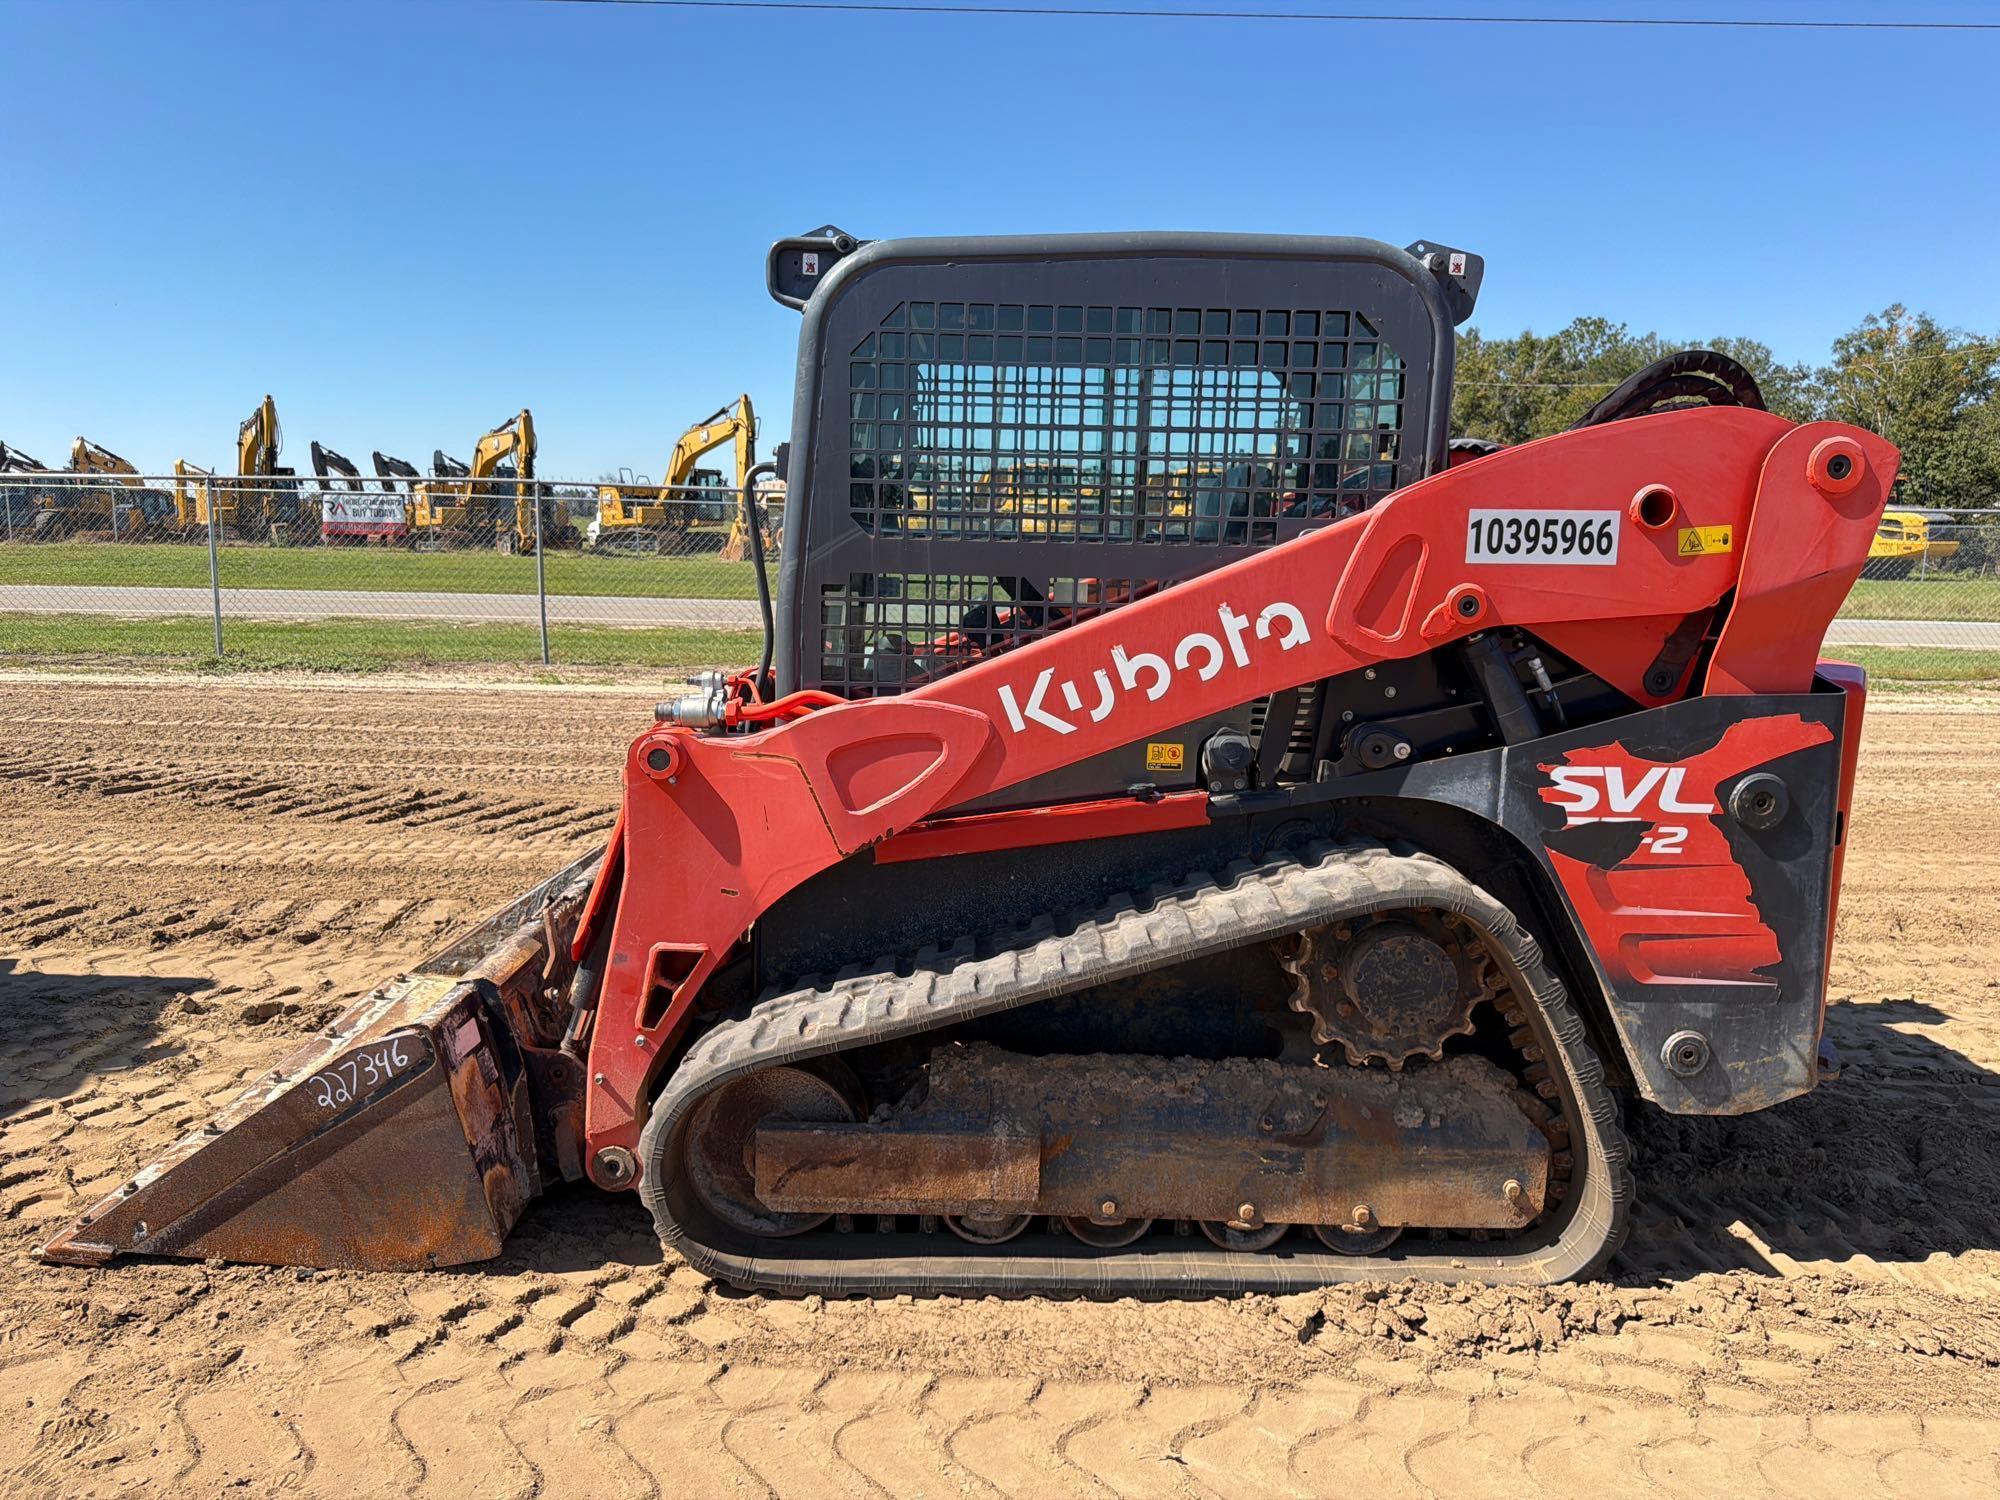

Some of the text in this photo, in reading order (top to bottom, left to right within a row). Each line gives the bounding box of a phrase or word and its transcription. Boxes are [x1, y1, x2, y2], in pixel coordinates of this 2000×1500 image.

[352, 508, 367, 518] BUY
[1470, 518, 1613, 556] 10395966
[997, 601, 1311, 735] Kubota
[1550, 766, 1715, 814] SVL
[308, 1039, 409, 1109] 227346
